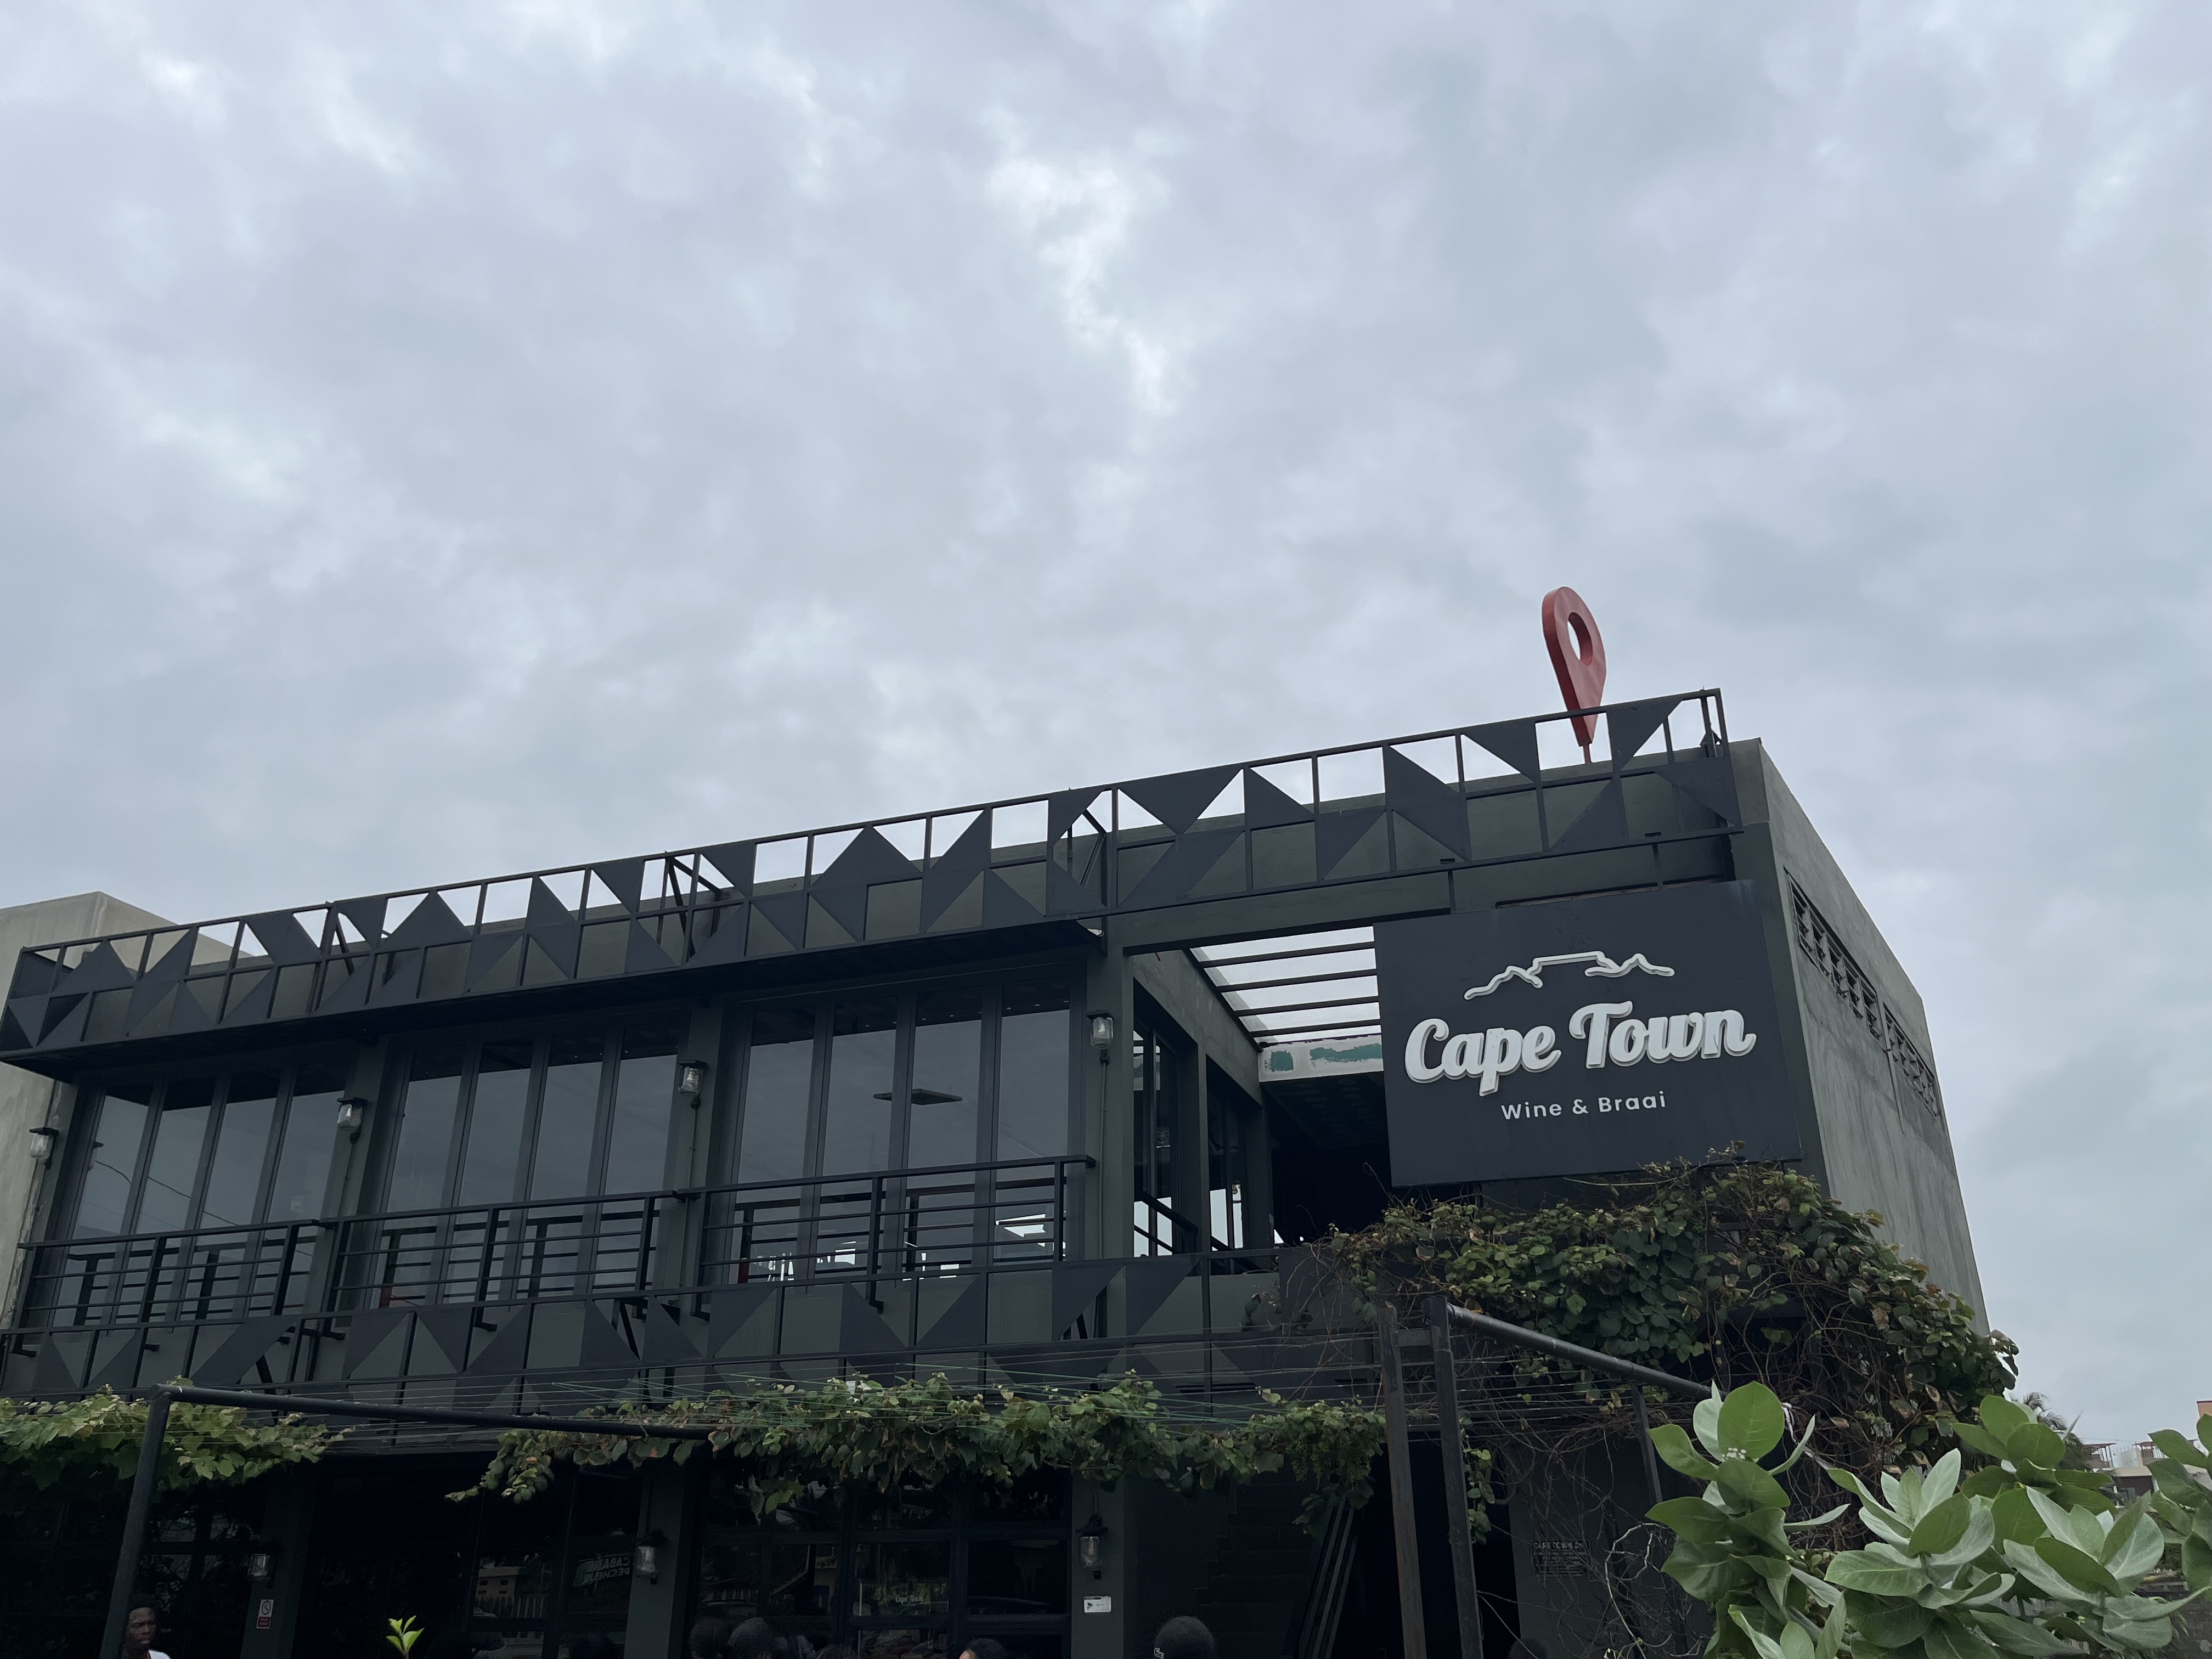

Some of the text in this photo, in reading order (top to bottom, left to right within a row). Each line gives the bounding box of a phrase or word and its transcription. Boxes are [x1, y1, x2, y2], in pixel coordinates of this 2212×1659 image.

[1405, 1001, 1756, 1096] Cape Town
[1501, 1091, 1666, 1120] Wine & Braai
